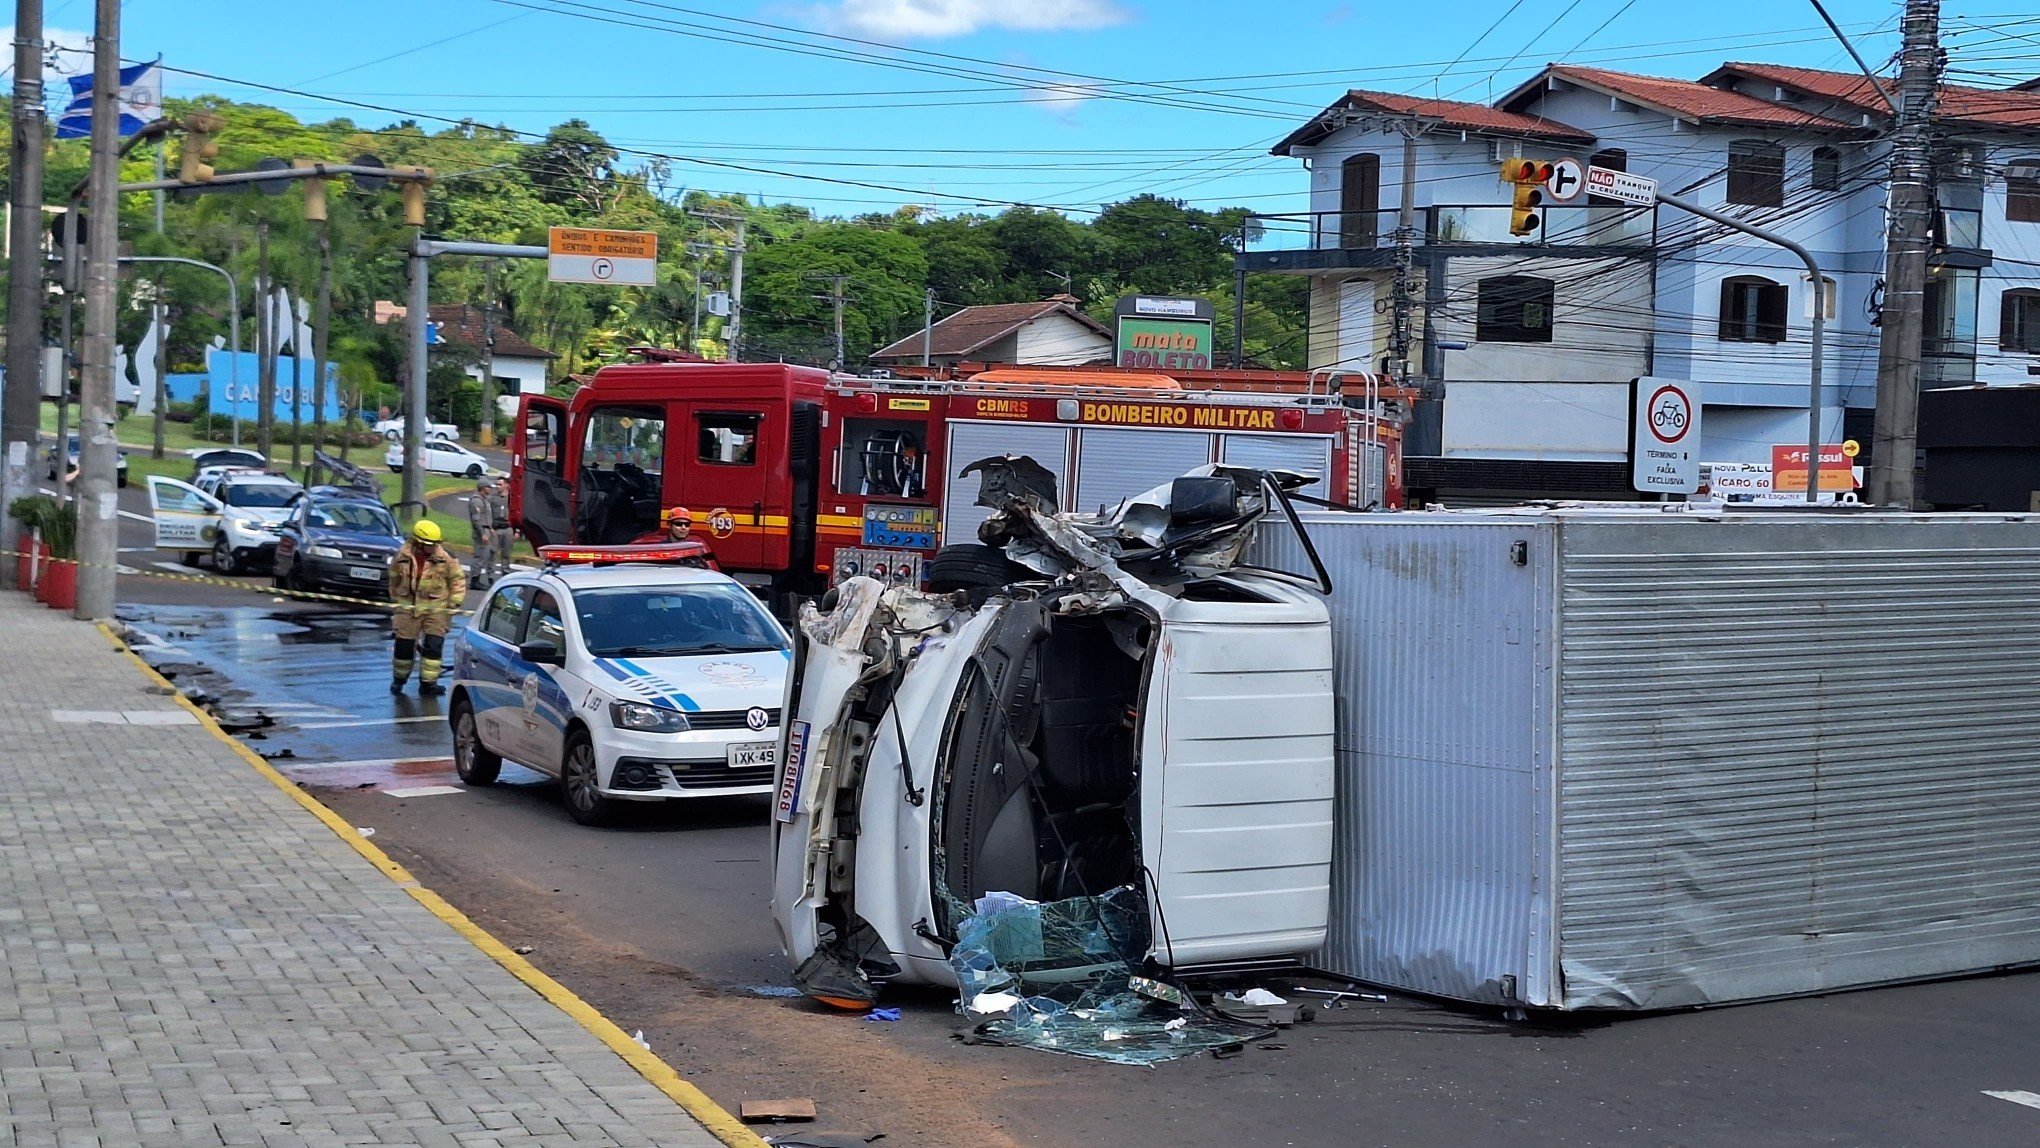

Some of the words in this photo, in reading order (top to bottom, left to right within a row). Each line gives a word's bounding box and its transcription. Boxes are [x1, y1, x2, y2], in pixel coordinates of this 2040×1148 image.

[1591, 171, 1613, 184] NÃO
[1617, 179, 1652, 192] TRANQUE
[1599, 186, 1650, 202] CRUZAMENTO
[593, 233, 599, 241] E
[562, 243, 592, 252] SENTIDO
[1133, 332, 1197, 350] mata
[1122, 350, 1207, 369] BOLETO
[977, 399, 1028, 412] CBMRS
[1084, 404, 1187, 424] BOMBEIRO
[1194, 407, 1275, 428] MILITAR
[1802, 453, 1843, 462] Rssul
[1657, 466, 1676, 474] FAIXA
[1647, 476, 1685, 485] EXCLUSIVA
[1756, 479, 1769, 488] 60
[712, 517, 733, 530] 193
